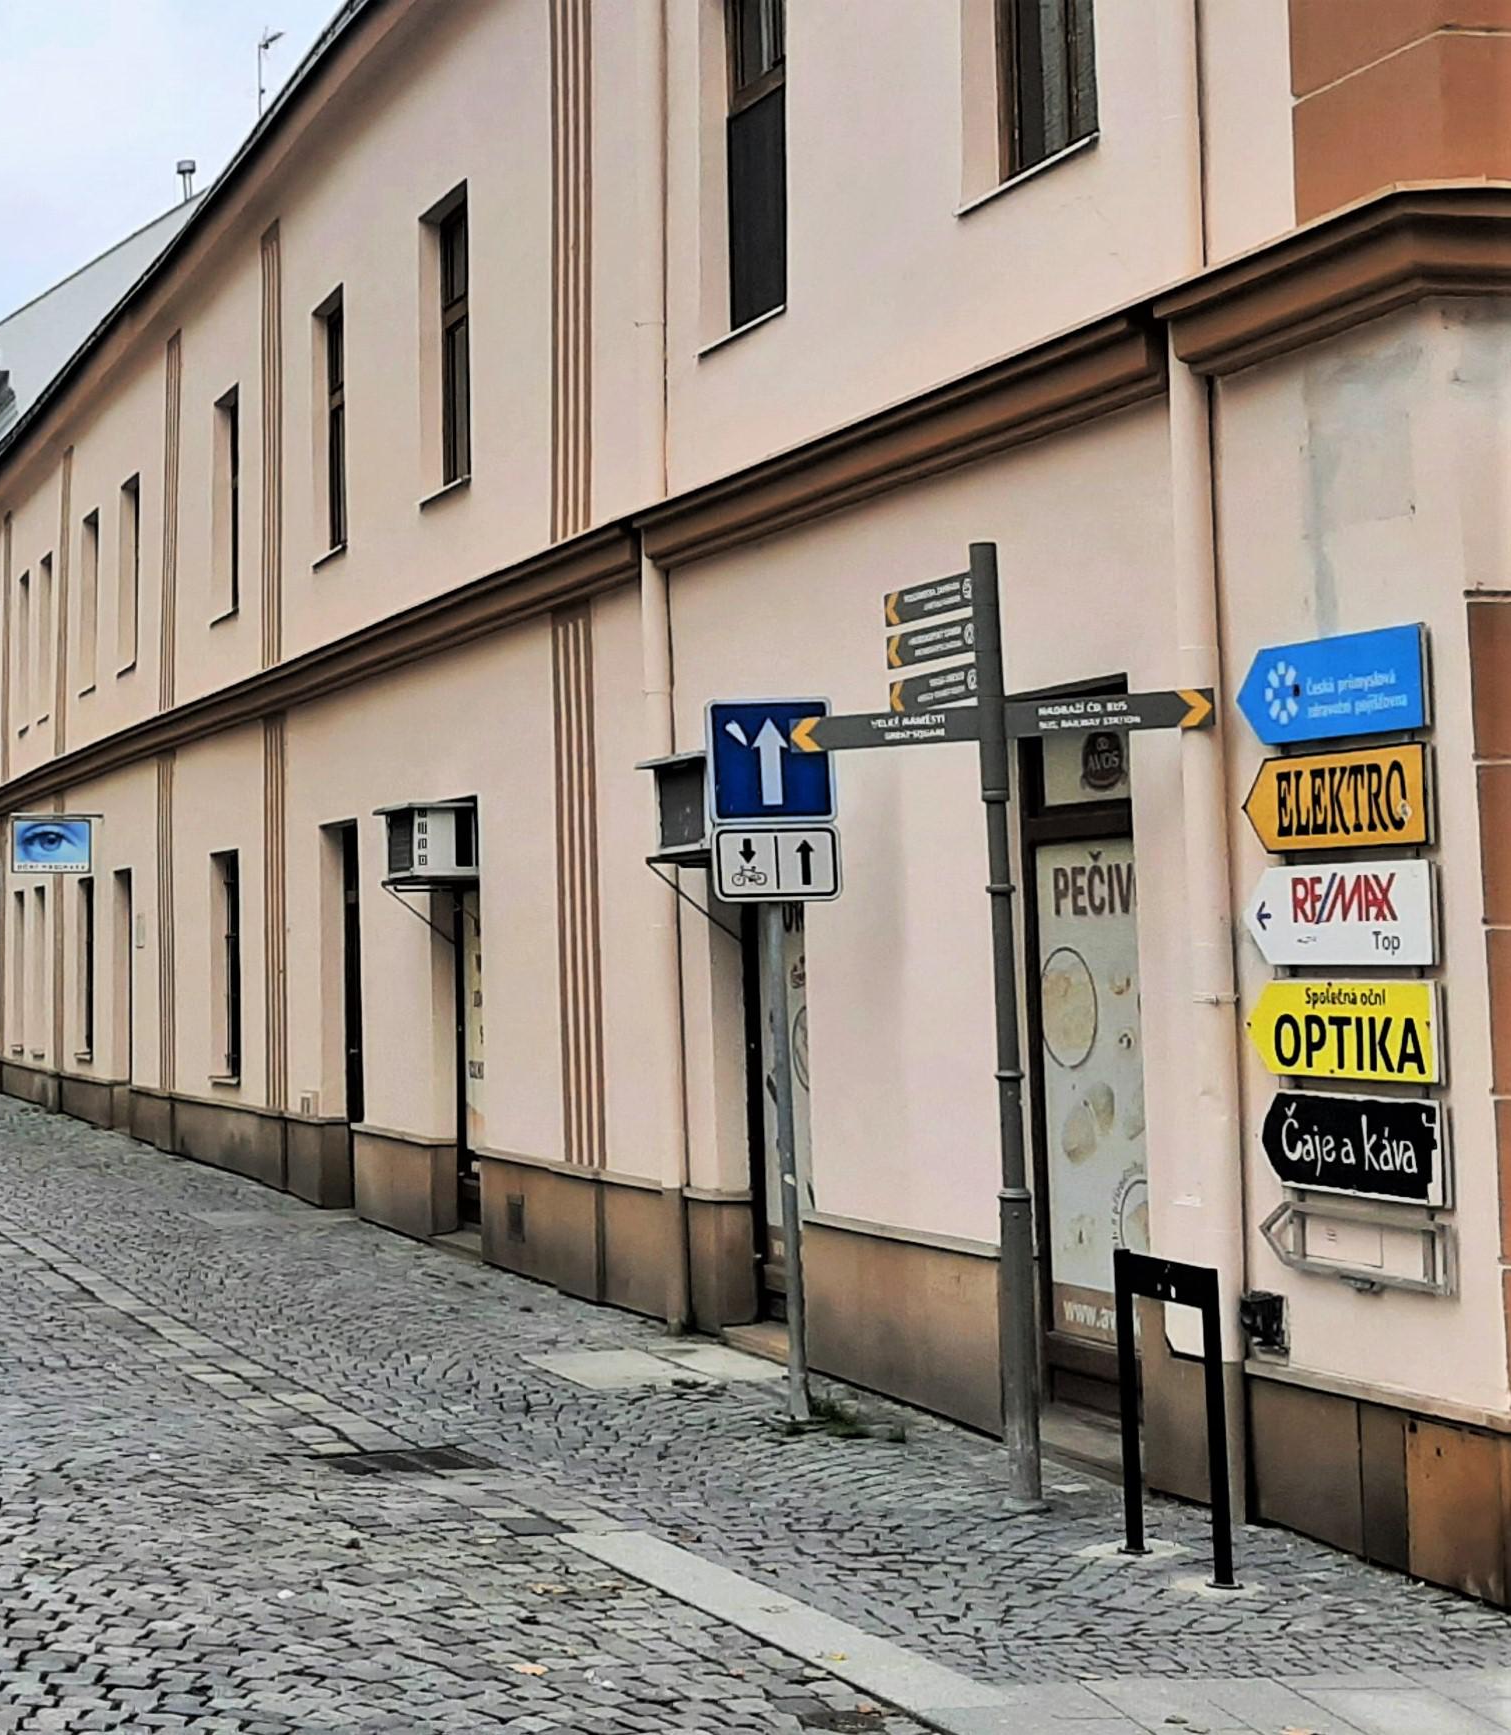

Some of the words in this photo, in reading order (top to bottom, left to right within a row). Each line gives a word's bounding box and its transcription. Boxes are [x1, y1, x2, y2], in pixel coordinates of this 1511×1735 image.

[1305, 676, 1335, 696] Česká
[1275, 760, 1408, 838] ELEKTRO
[1052, 850, 1137, 917] PEČIV
[1291, 872, 1399, 925] RE/MAX
[1372, 931, 1401, 956] Top
[1305, 986, 1358, 1010] Společná
[1274, 1013, 1427, 1075] OPTIKA
[1281, 1101, 1336, 1176] Čaje
[1340, 1136, 1357, 1165] a
[1361, 1113, 1419, 1174] káva
